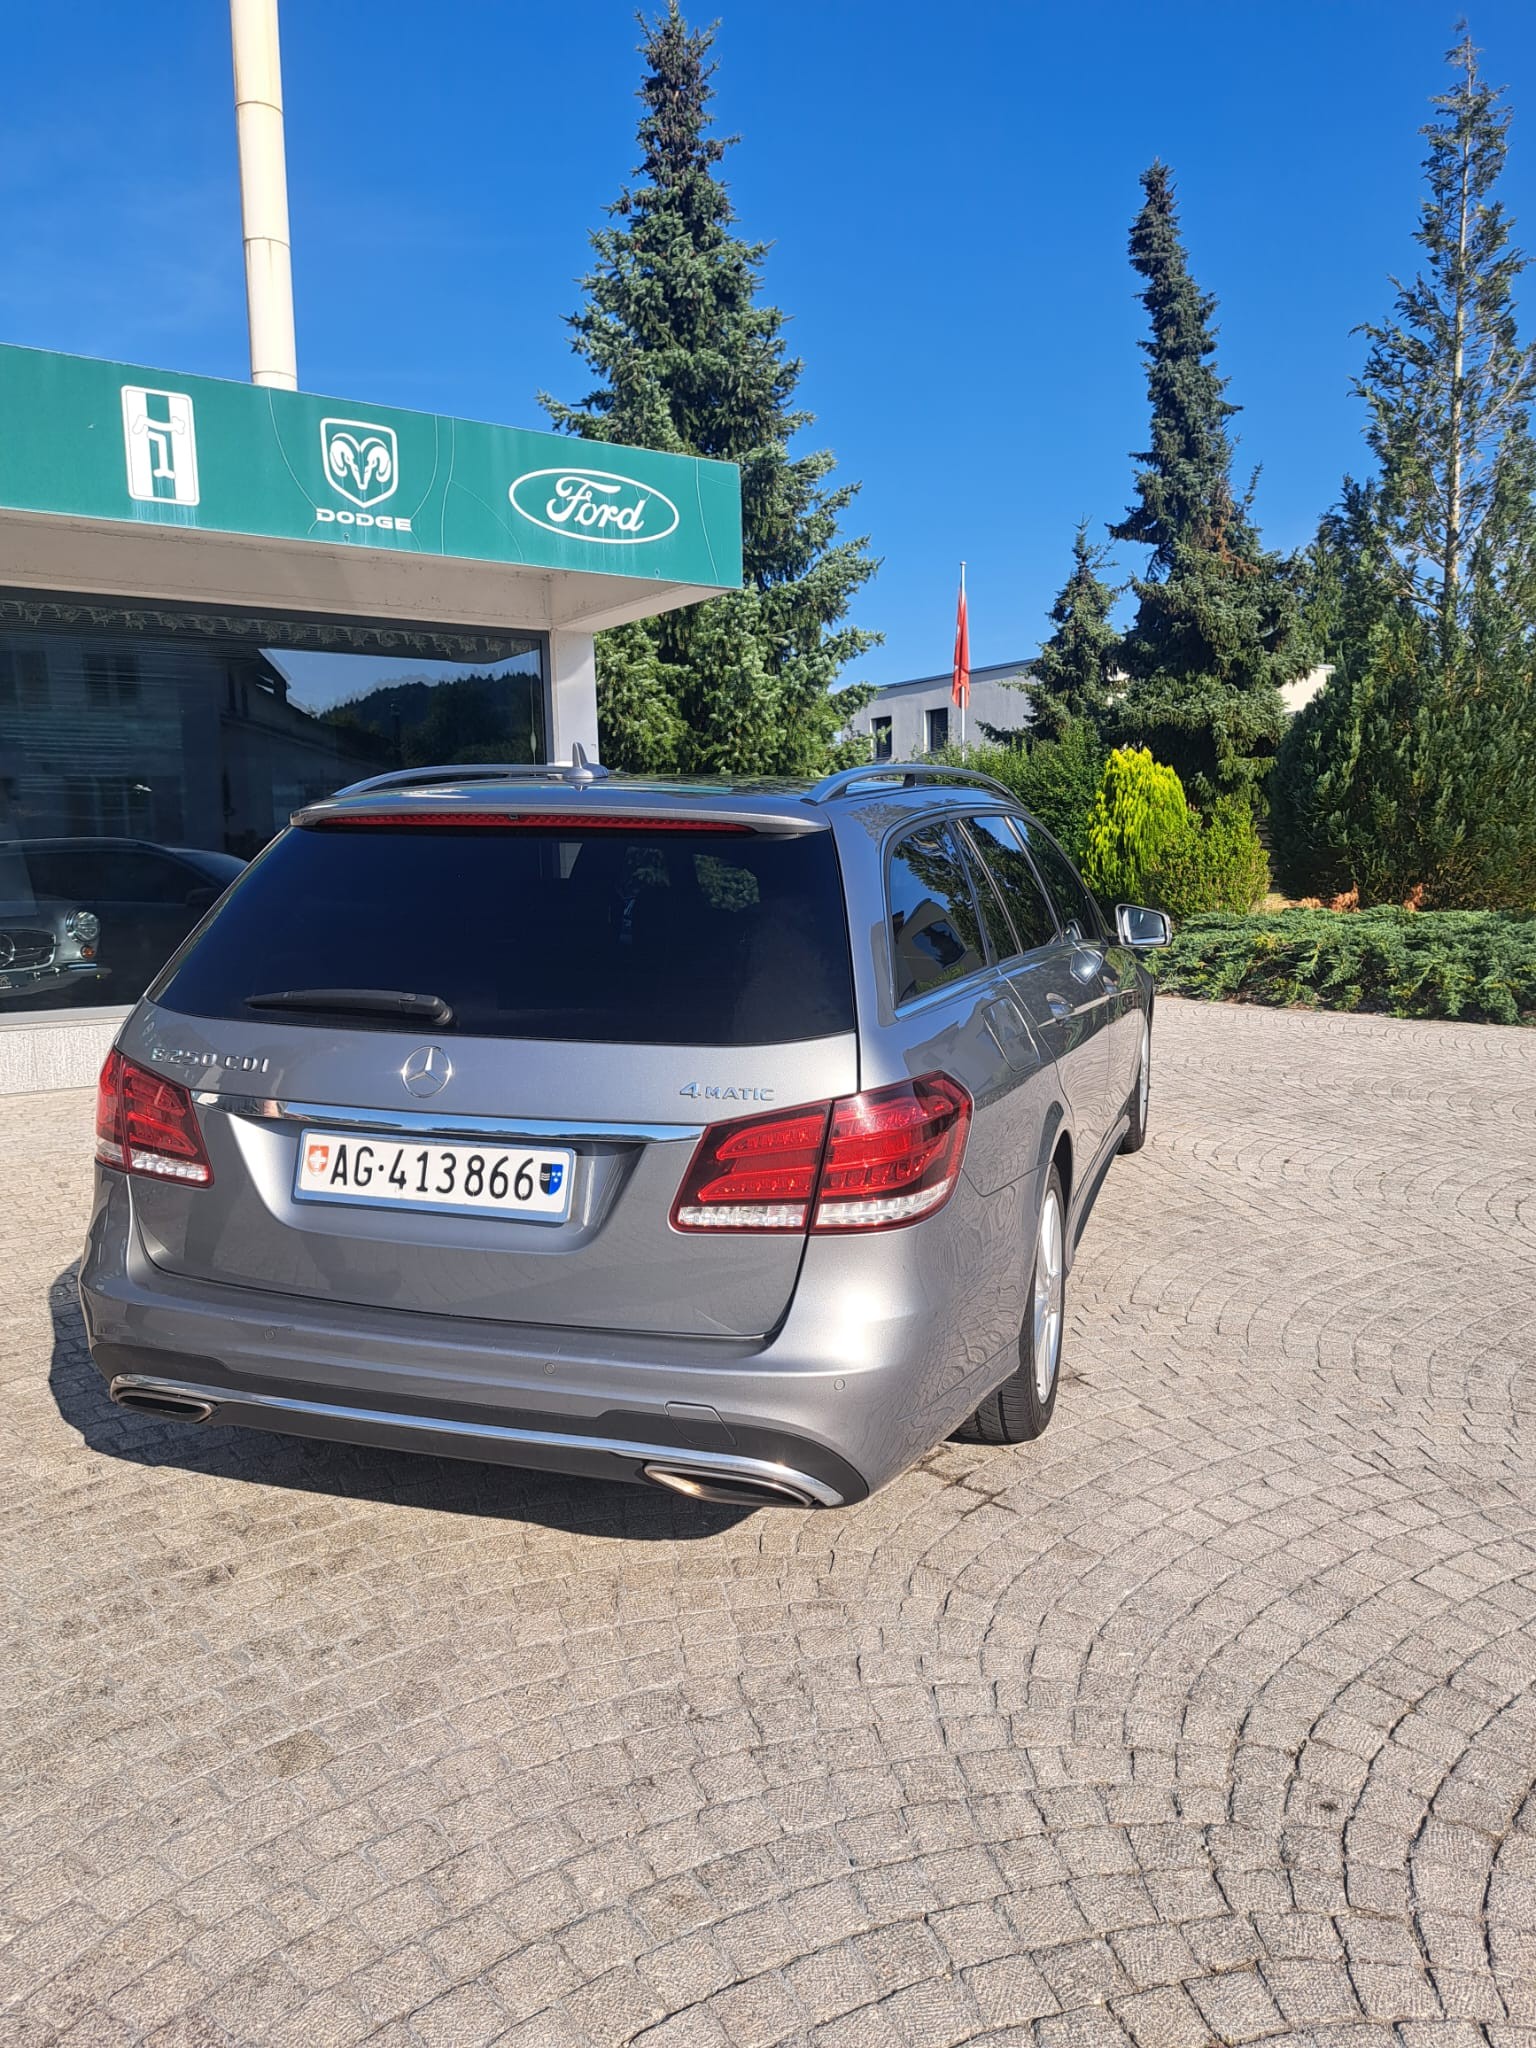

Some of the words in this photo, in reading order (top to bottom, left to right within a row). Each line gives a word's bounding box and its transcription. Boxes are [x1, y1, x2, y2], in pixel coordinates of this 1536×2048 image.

[546, 476, 645, 532] Ford
[316, 508, 412, 531] DODGE
[225, 1055, 269, 1073] CDI
